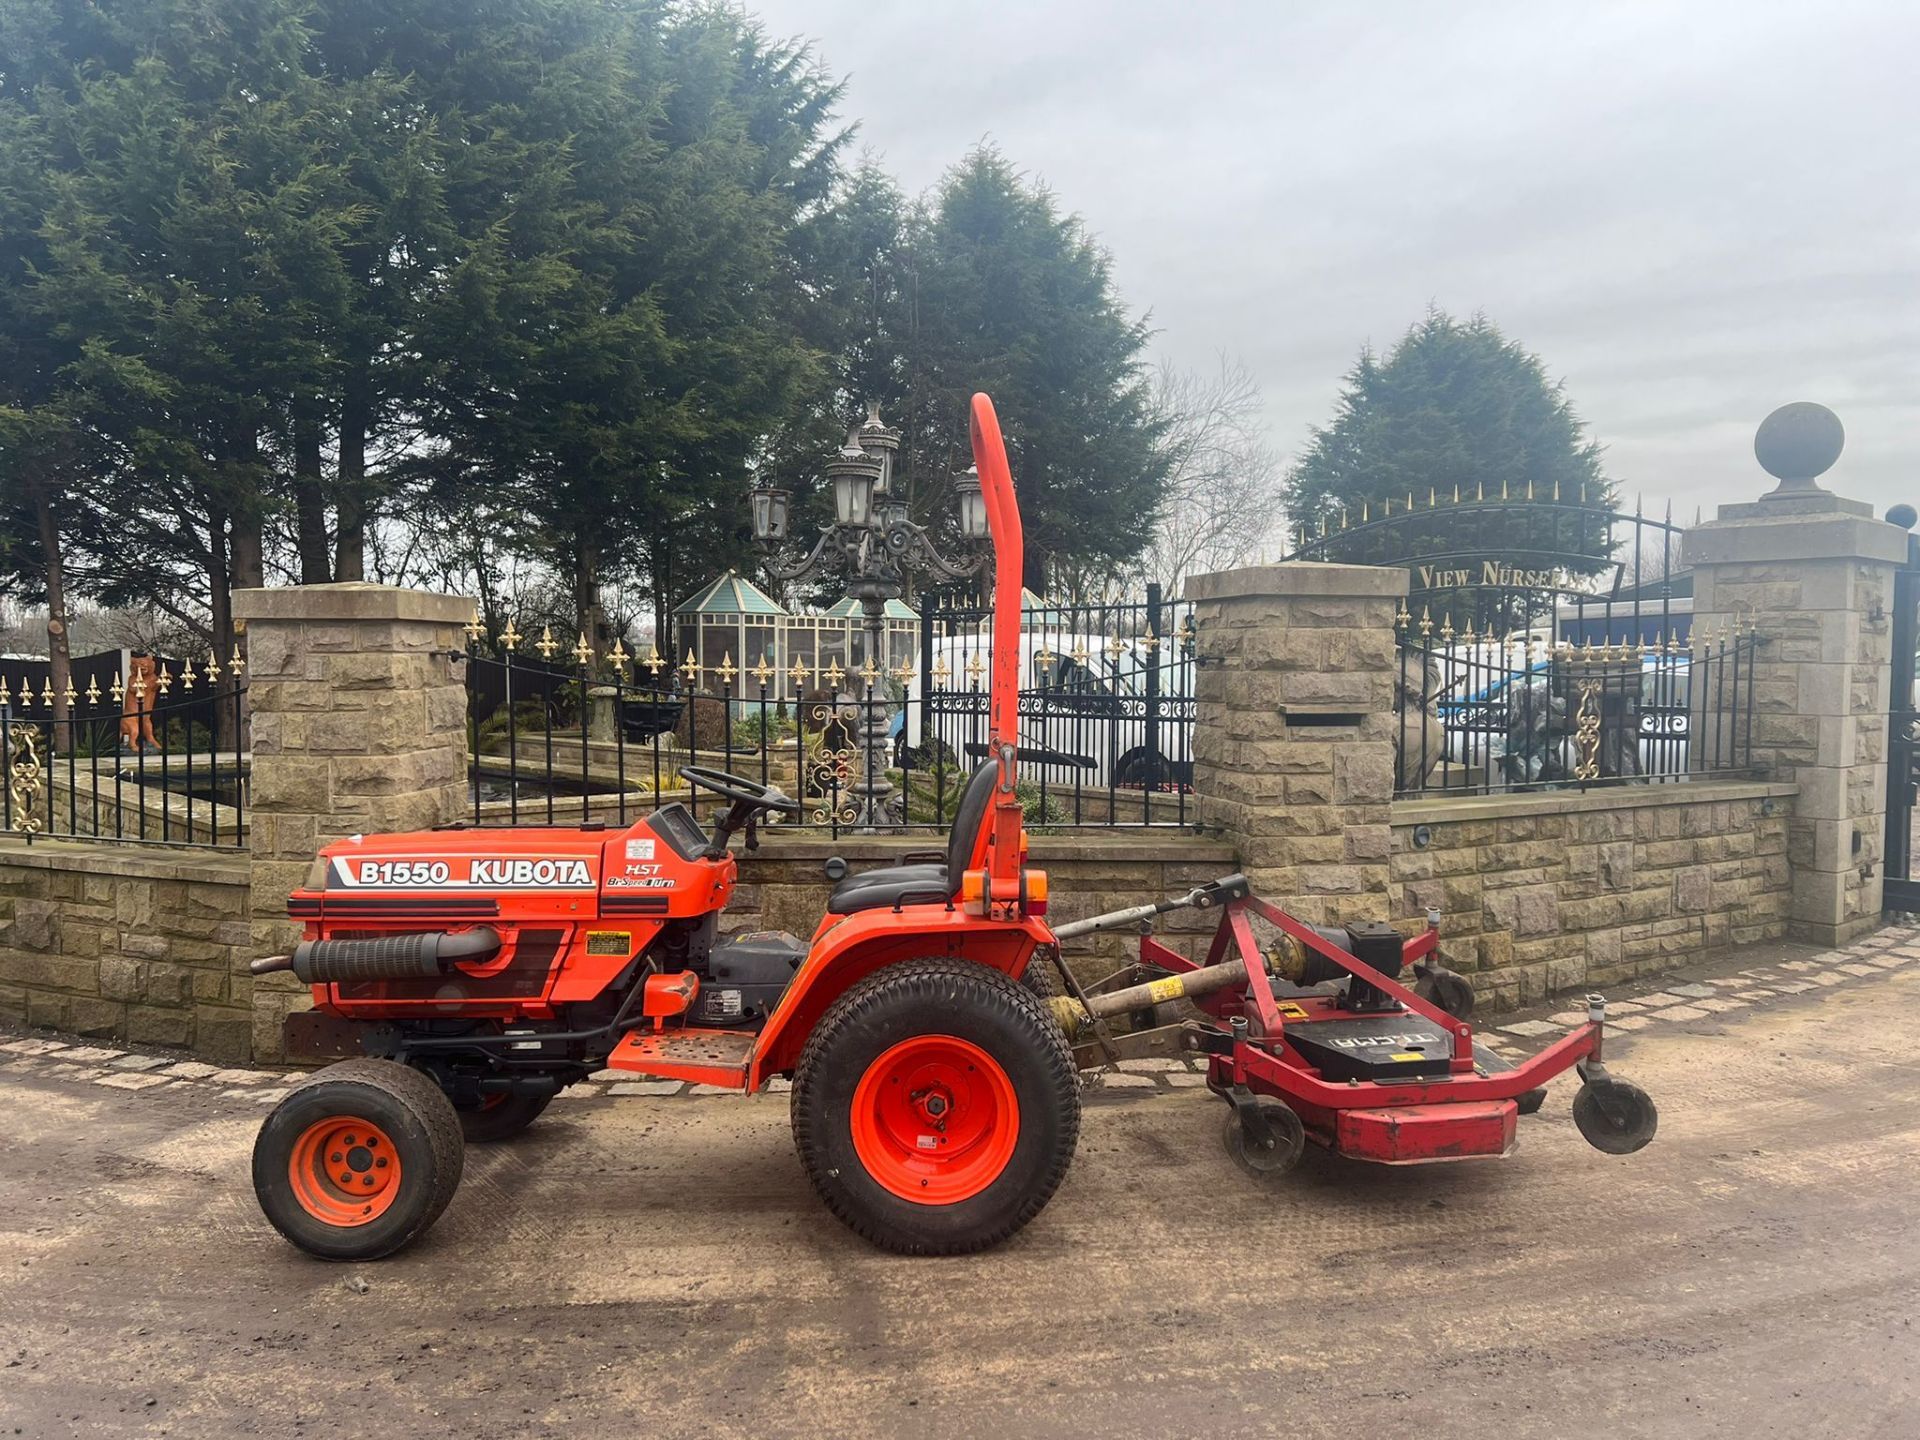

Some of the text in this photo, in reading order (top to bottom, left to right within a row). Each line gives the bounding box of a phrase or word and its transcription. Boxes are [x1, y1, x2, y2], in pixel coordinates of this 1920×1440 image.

[1418, 565, 1469, 588] VIEW
[358, 859, 592, 885] B1550 KUBOTA
[625, 864, 663, 875] HST
